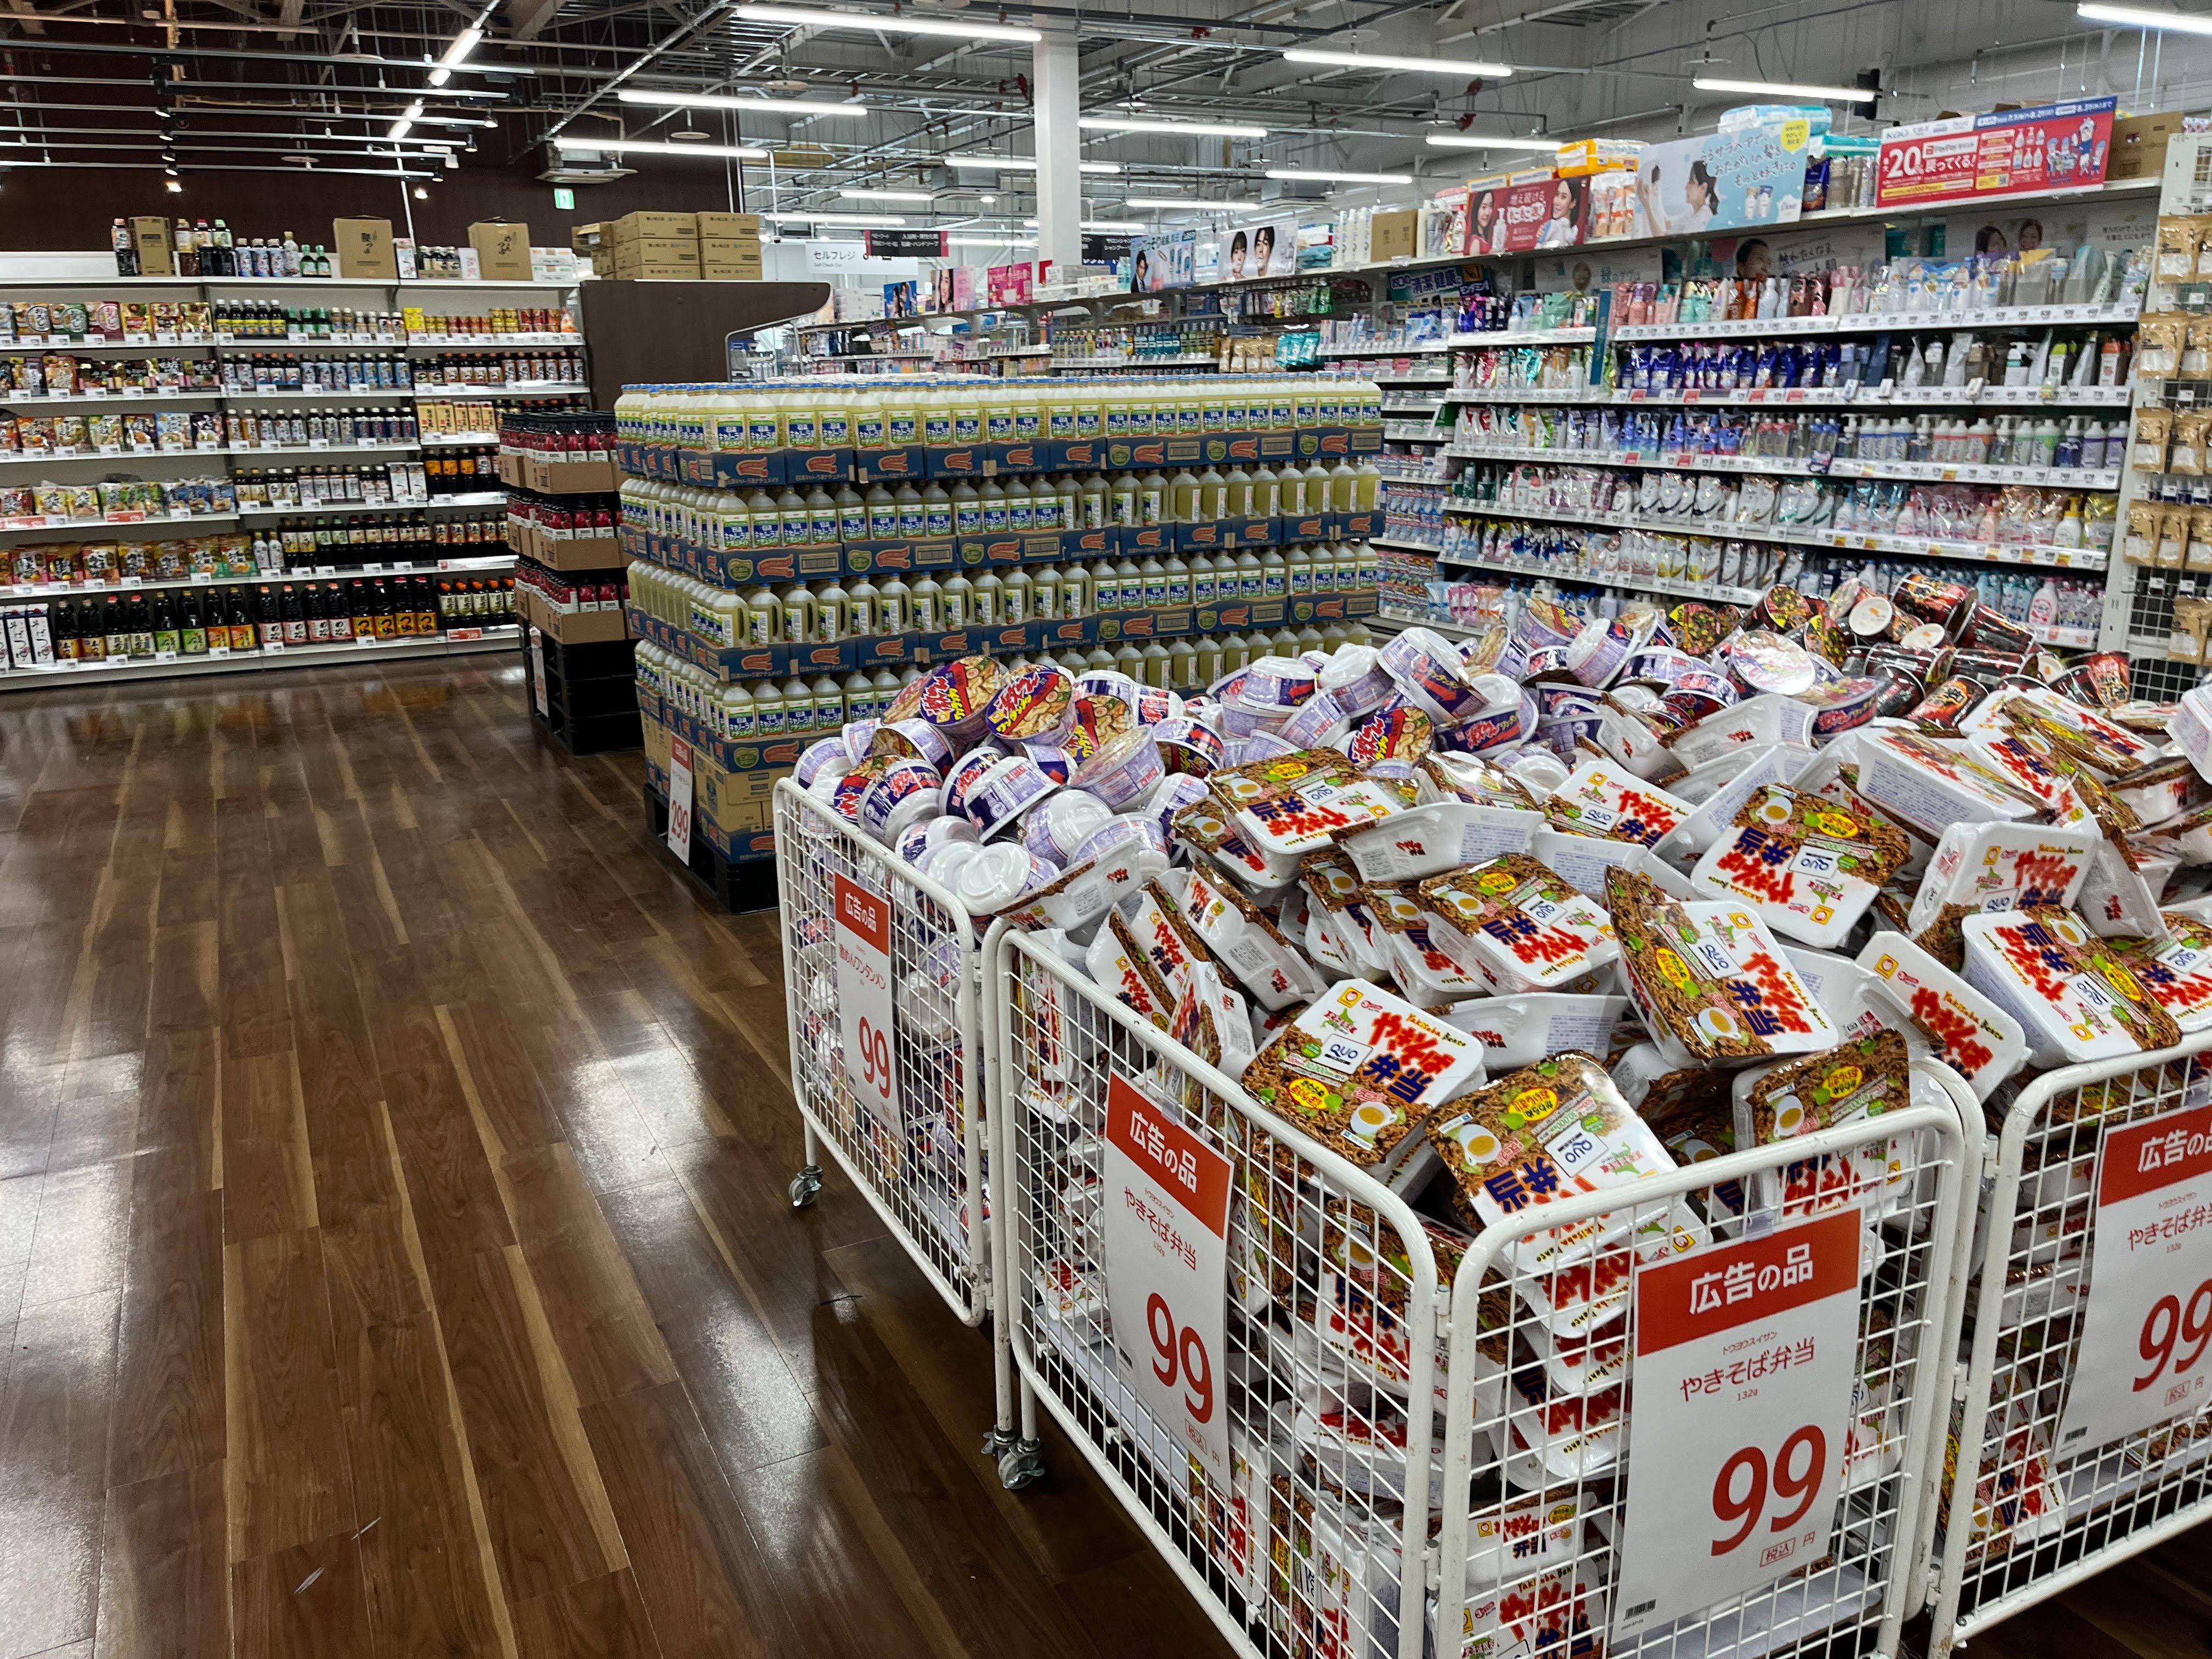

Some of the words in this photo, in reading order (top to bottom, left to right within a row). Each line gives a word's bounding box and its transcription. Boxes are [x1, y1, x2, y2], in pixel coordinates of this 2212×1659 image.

[813, 251, 855, 260] セルフレジ
[1247, 795, 1306, 822] 弁当
[1311, 787, 1333, 800] QUO
[1588, 809, 1612, 821] QUO
[672, 799, 689, 844] 299
[1266, 804, 1351, 837] やきそば
[1732, 826, 1794, 867] 弁当
[1800, 858, 1829, 871] QUO
[1716, 852, 1795, 904] やきそば
[844, 891, 877, 933] 広告の品
[1481, 912, 1540, 945] 弁当
[1536, 904, 1555, 918] QUO
[1149, 945, 1176, 977] 弁当
[1154, 921, 1185, 965] やきそば
[1510, 925, 1590, 964] やきそば
[1705, 944, 1729, 968] QUO
[1994, 926, 2068, 1002] やきそば
[2015, 922, 2074, 972] 弁当
[1120, 968, 1153, 1013] やきそば
[1725, 979, 1786, 1036] 弁当
[1740, 952, 1813, 1034] やきそば
[1330, 1044, 1358, 1059] QUO
[1368, 1011, 1456, 1075] やきそば
[1910, 987, 1994, 1073] やきそば
[859, 1015, 891, 1099] 99
[1362, 1053, 1434, 1104] 弁当
[1129, 1108, 1198, 1194] 広告の品
[1565, 1139, 1592, 1164] QUO
[2137, 1118, 2212, 1174] 広告の
[1483, 1156, 1560, 1214] 弁当
[1124, 1185, 1198, 1272] やきそば弁当
[1688, 1242, 1814, 1316] 広告の品
[1146, 1291, 1214, 1424] 99
[1722, 1331, 1778, 1355] トウヨウスイサン
[2132, 1277, 2212, 1393] 99
[1679, 1336, 1816, 1403] やきそば弁当
[1736, 1388, 1759, 1402] 132g
[1710, 1424, 1827, 1558] 99
[1765, 1542, 1791, 1562] 税込
[1803, 1531, 1816, 1548] 円
